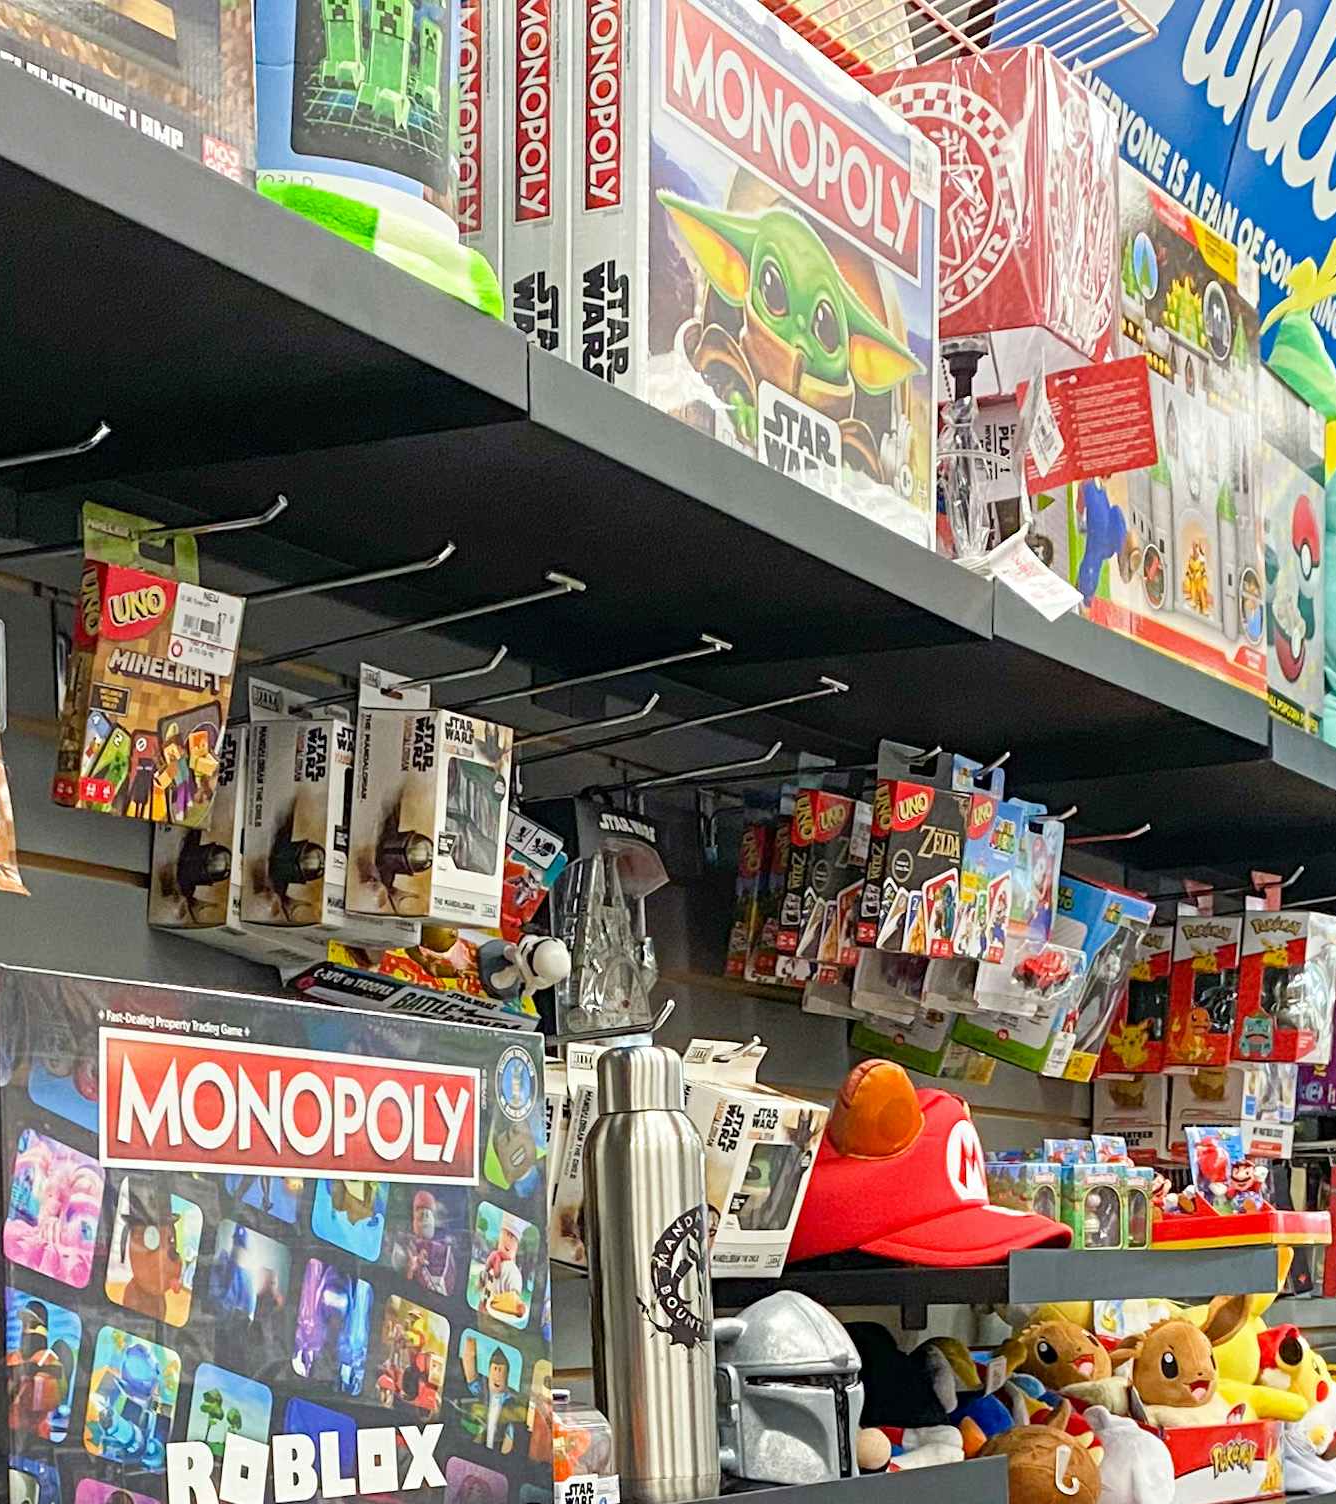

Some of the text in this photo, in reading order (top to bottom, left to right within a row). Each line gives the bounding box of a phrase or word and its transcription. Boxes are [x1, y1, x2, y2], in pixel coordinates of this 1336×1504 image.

[672, 10, 915, 256] MONOPOLY
[1170, 153, 1189, 194] IS
[1203, 187, 1239, 245] FAN
[1238, 219, 1263, 259] OF
[764, 399, 836, 468] STAR
[109, 587, 166, 627] UNO
[107, 649, 225, 693] MINECRAFT
[445, 717, 473, 732] STAR
[445, 728, 474, 744] WARS
[898, 793, 930, 822] UNO
[106, 1009, 244, 1037] Fast-Dealing Property Trading Game
[116, 1050, 471, 1164] MONOPOLY
